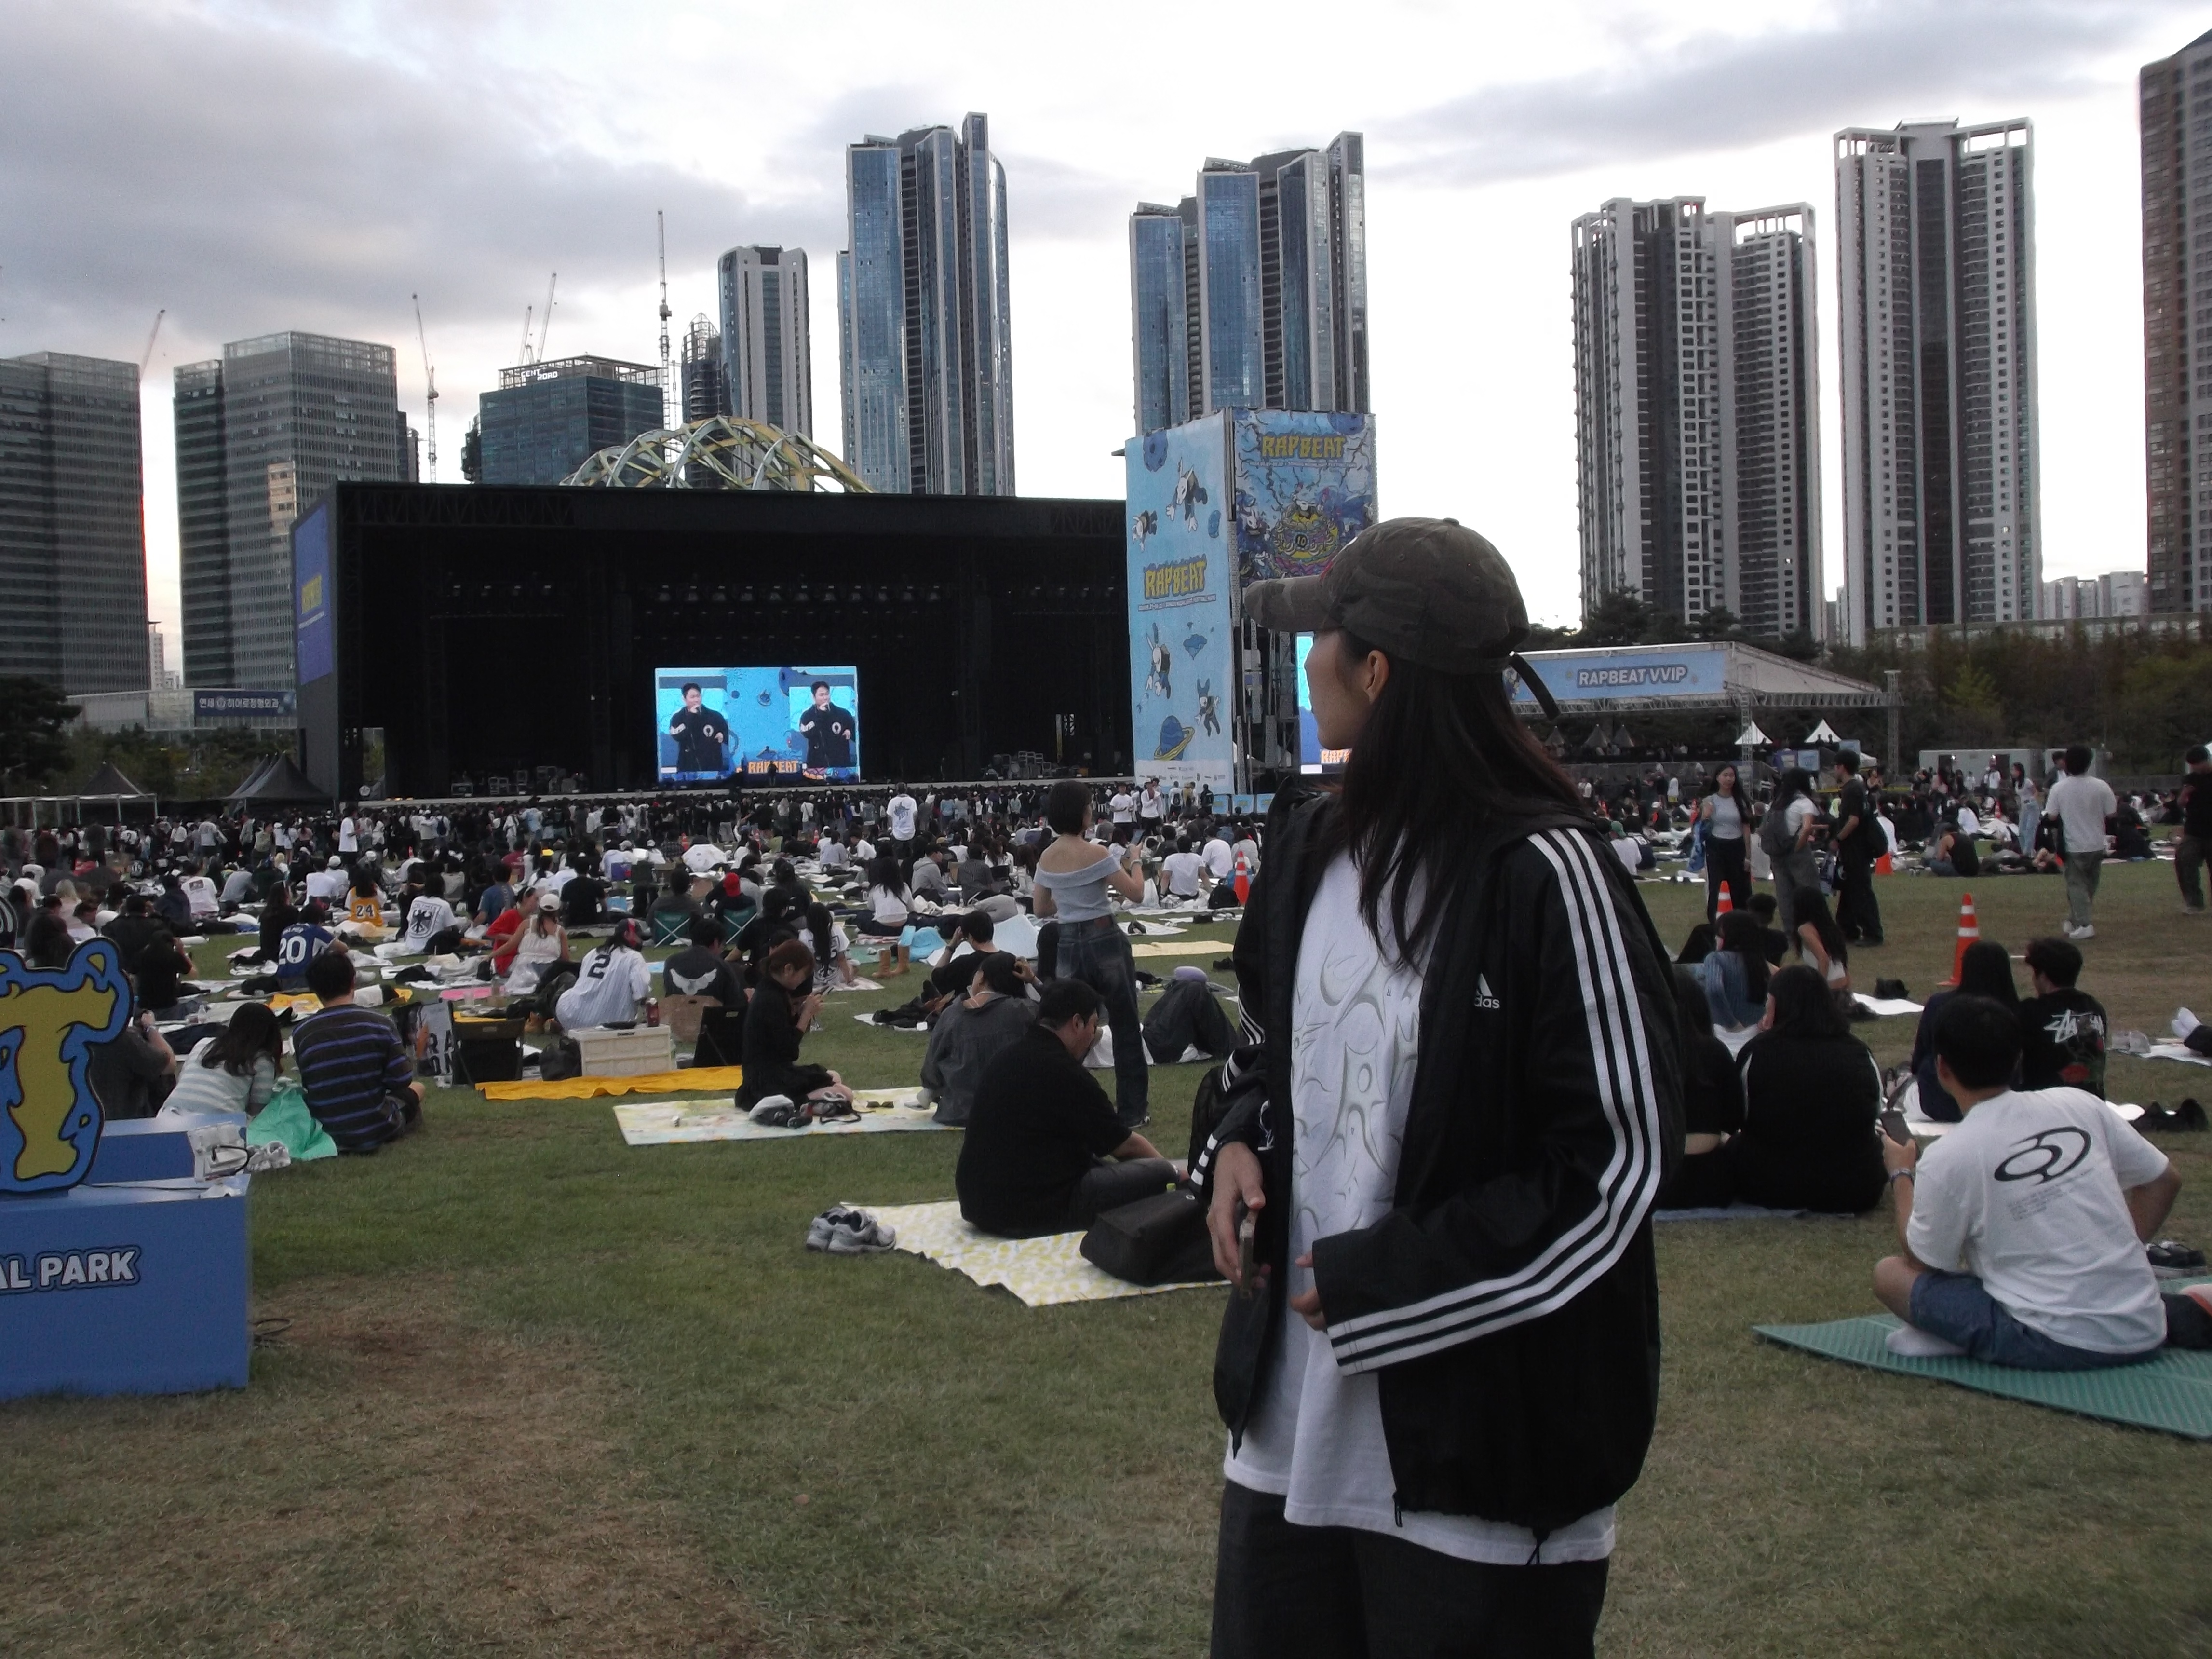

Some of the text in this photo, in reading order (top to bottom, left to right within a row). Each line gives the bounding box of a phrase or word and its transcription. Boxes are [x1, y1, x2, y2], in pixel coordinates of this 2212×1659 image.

[1262, 435, 1346, 458] RAPBEAT
[1297, 535, 1307, 546] 10
[1145, 560, 1206, 598] RAPBEAT
[1579, 666, 1686, 686] RAPBEAT VVIP
[748, 761, 798, 774] RAPEAT
[356, 904, 375, 918] 24
[278, 935, 307, 964] 20
[587, 954, 611, 980] 2
[40, 1250, 135, 1287] PARK
